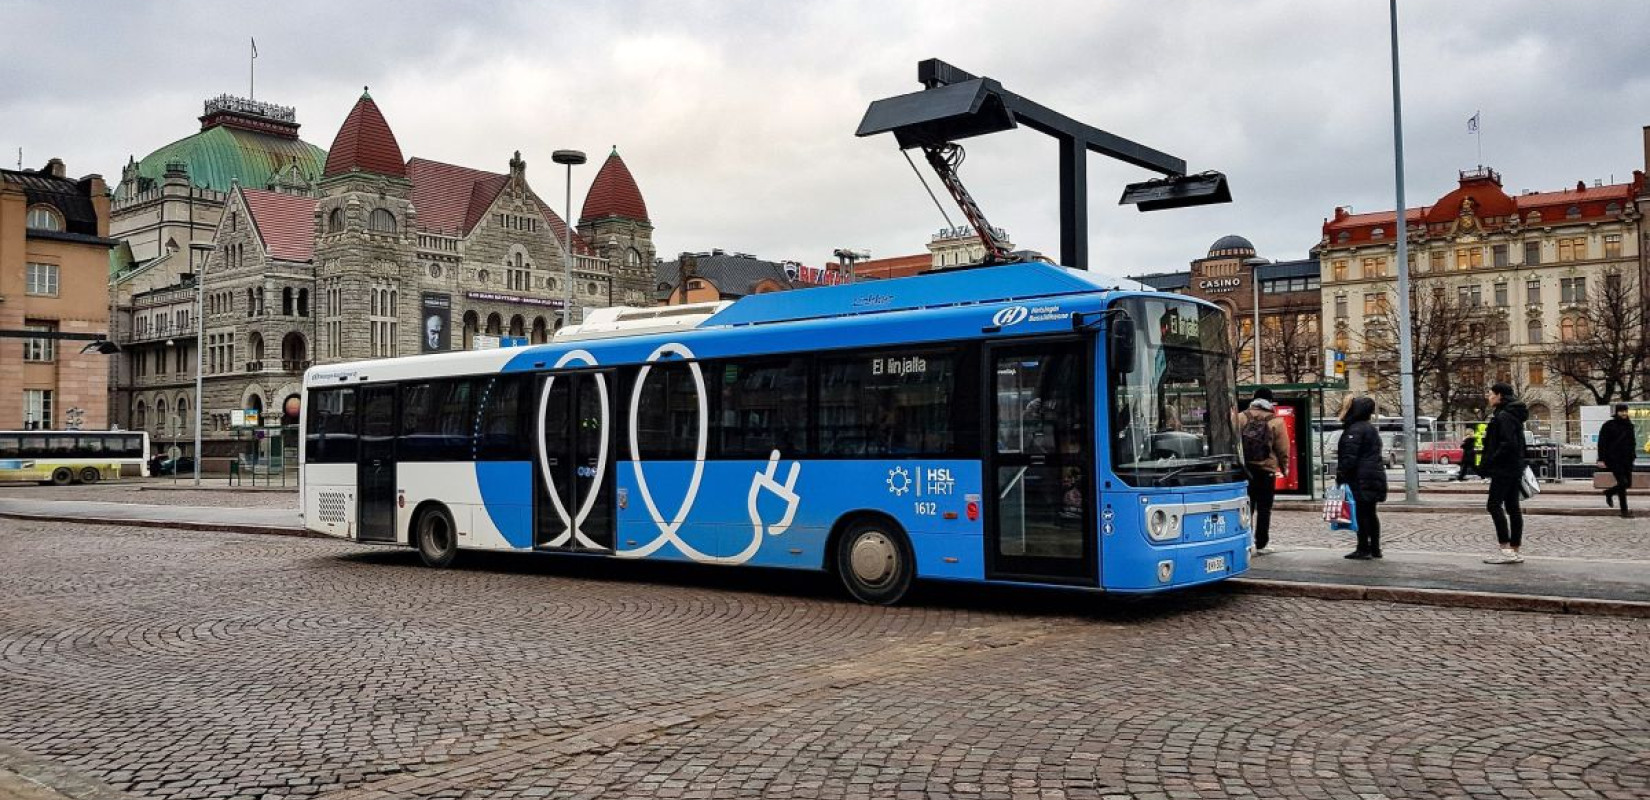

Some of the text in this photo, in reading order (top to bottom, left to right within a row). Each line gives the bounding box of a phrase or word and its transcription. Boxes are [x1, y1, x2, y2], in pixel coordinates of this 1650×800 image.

[1199, 278, 1240, 288] CASINO
[927, 468, 955, 481] HSL
[927, 481, 955, 494] HRT
[914, 501, 936, 515] 1612
